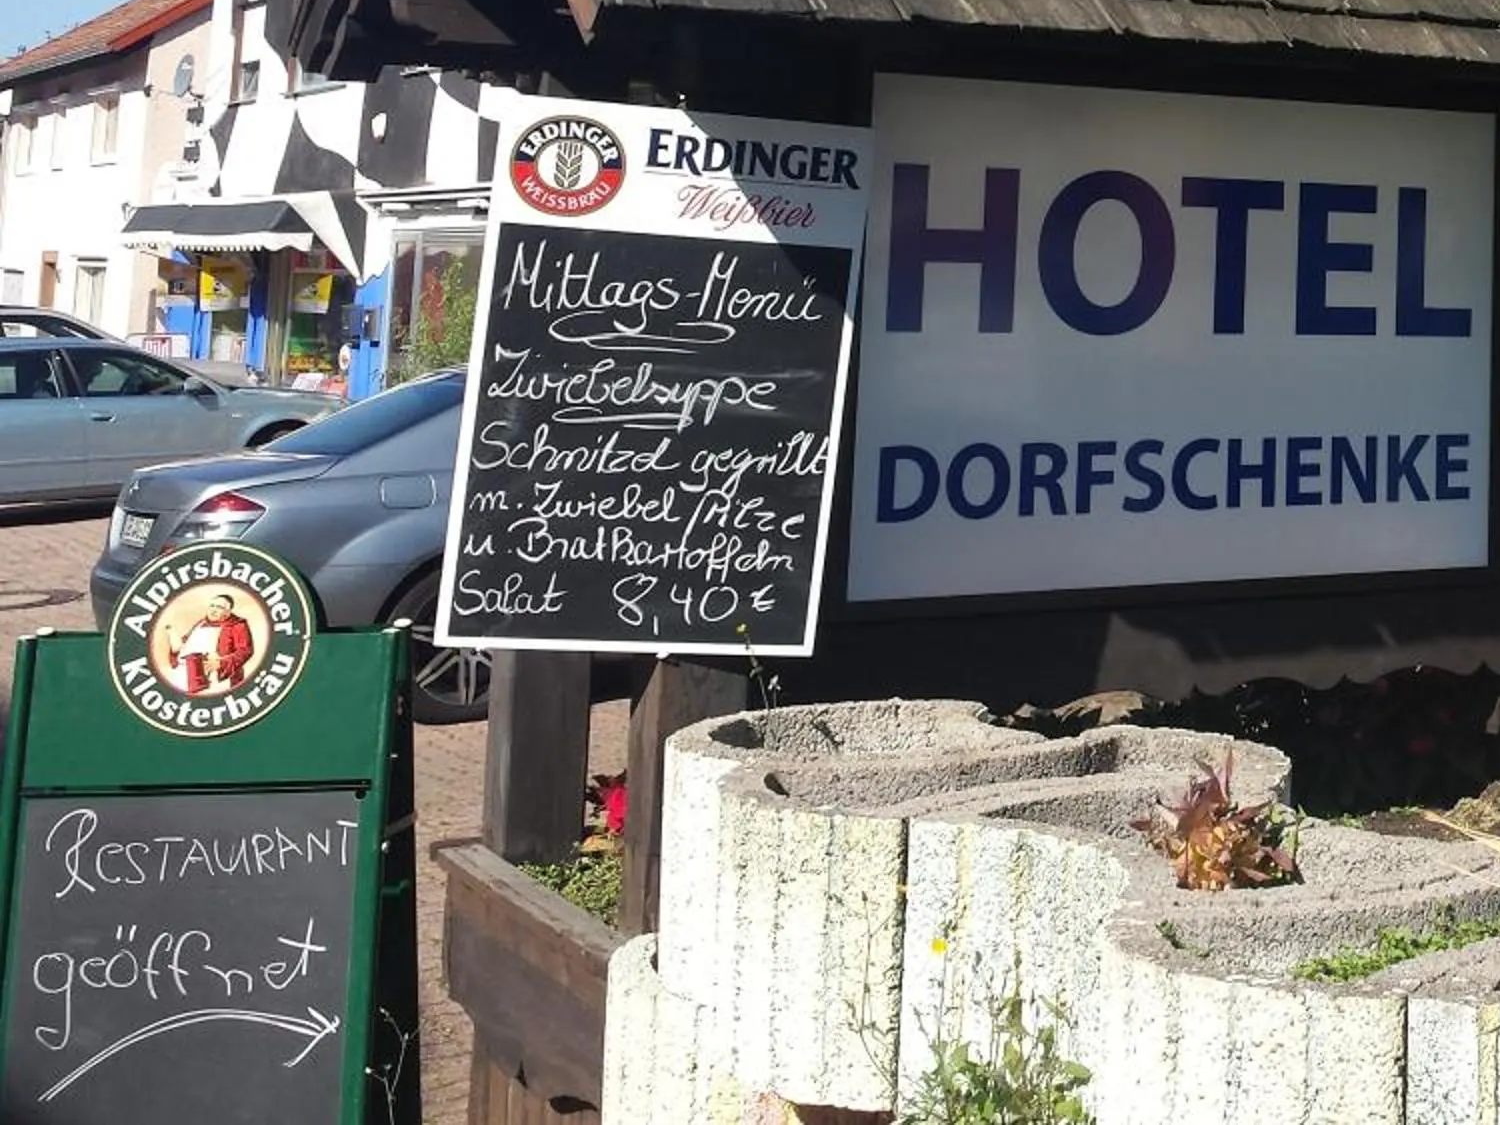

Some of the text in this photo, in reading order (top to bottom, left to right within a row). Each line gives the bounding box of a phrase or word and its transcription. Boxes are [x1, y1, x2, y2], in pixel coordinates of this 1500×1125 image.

[519, 120, 619, 164] ERDINGER
[644, 127, 860, 190] ERDINGER
[676, 184, 817, 232] Weißbier
[885, 162, 1473, 338] HOTEL
[532, 479, 681, 522] Zwiebel
[876, 433, 1471, 523] DORFSCHENKE
[124, 551, 294, 638] Alpirsbacher
[453, 569, 569, 616] Salat
[121, 652, 295, 728] Klosterbräu
[33, 917, 327, 1051] geöffnet
